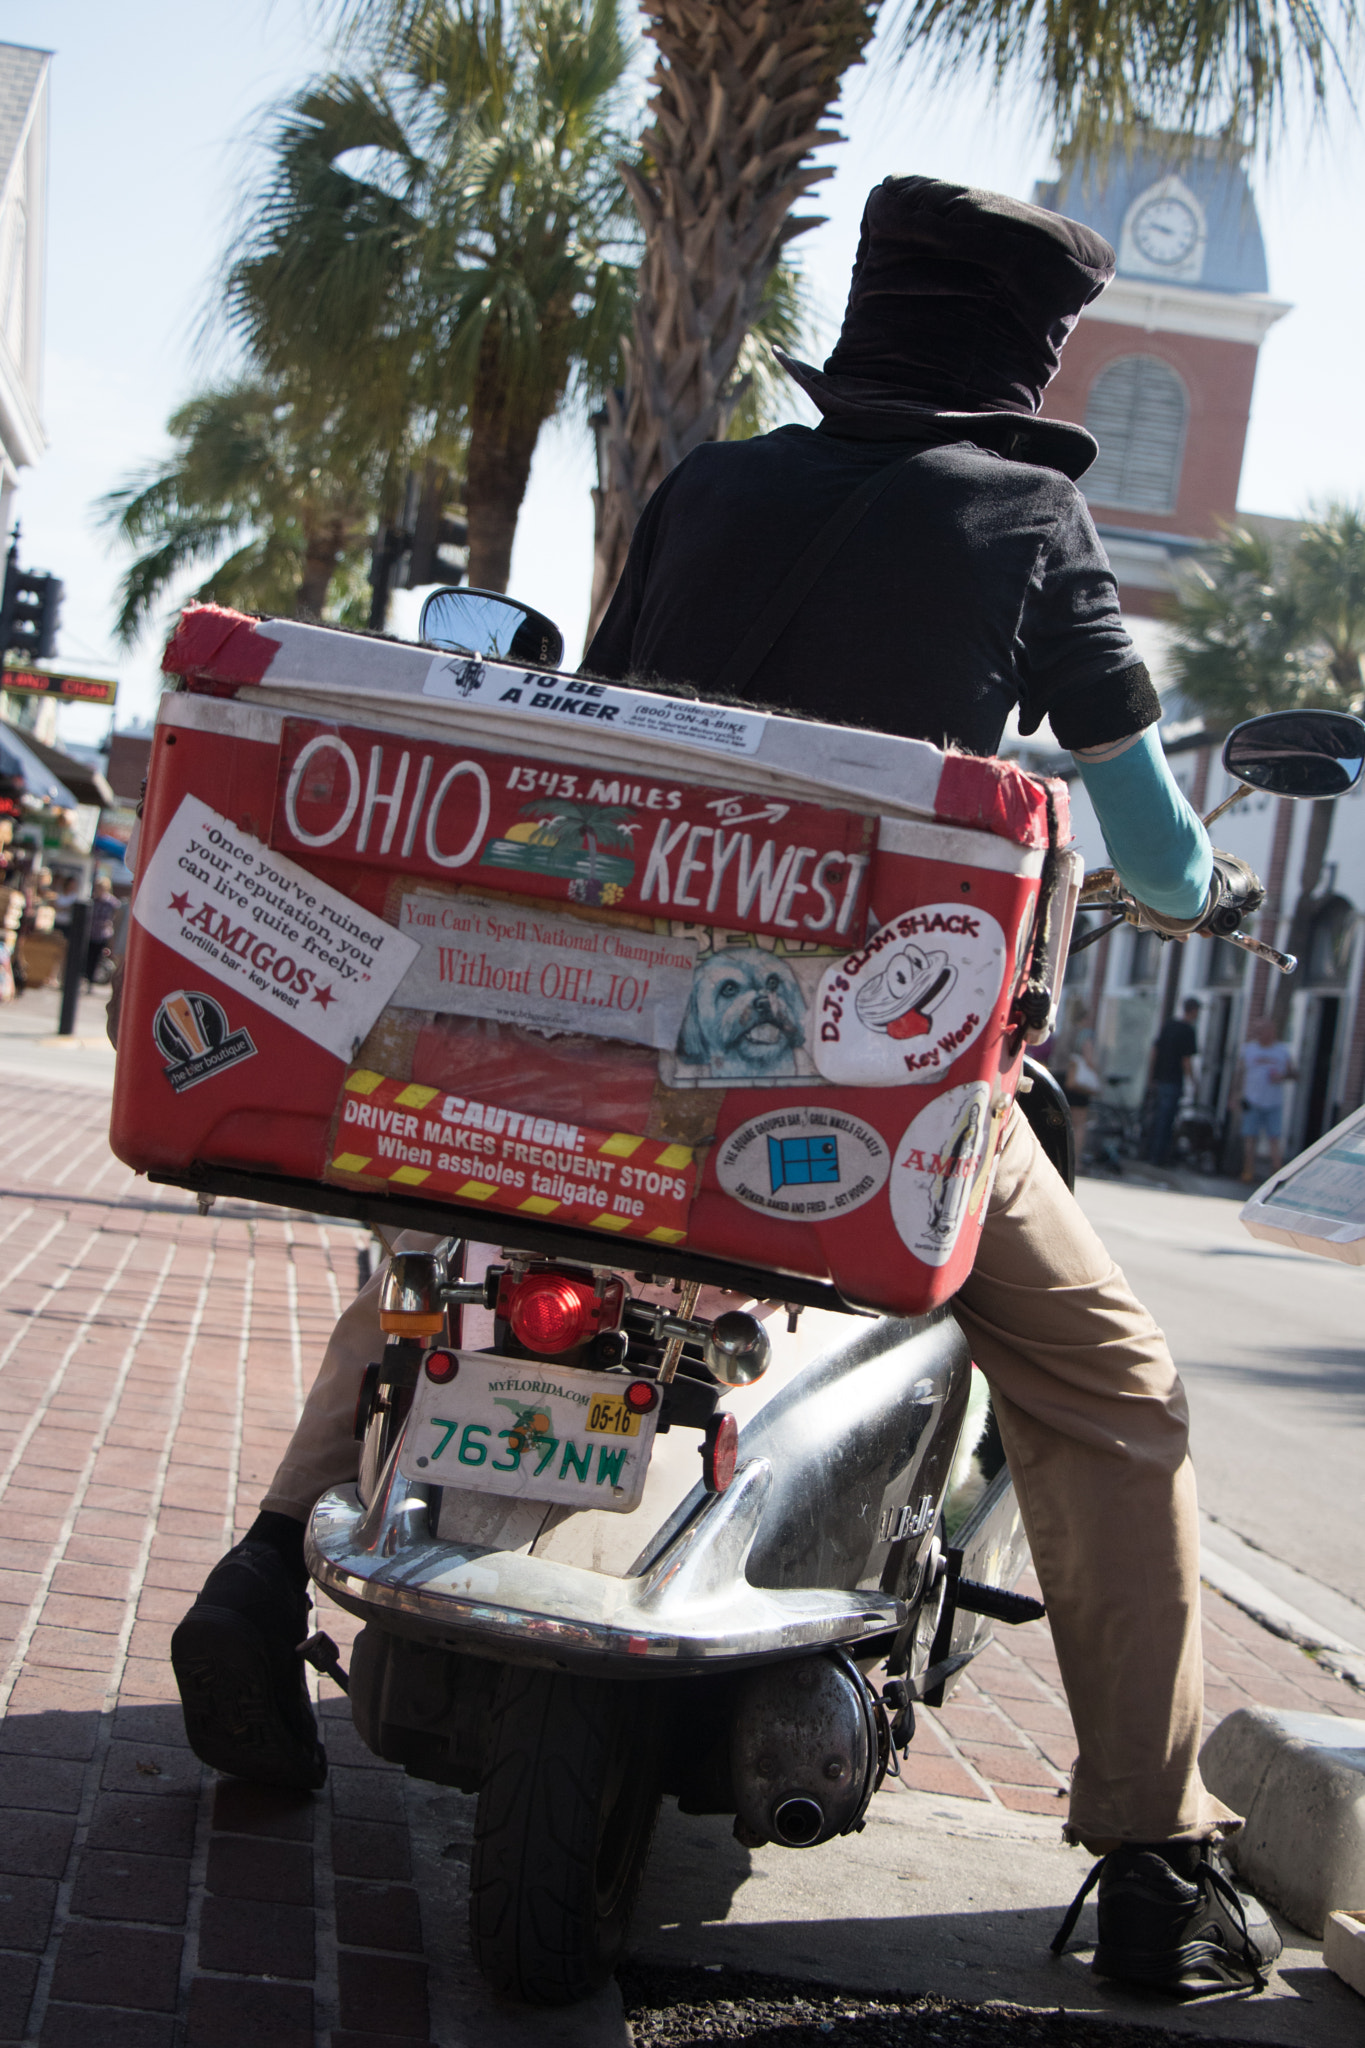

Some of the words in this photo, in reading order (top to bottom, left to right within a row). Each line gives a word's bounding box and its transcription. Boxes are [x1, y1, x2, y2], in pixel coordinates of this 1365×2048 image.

[499, 687, 526, 703] A
[528, 692, 620, 722] BIKER
[523, 672, 557, 688] TO
[564, 681, 608, 697] BE
[635, 705, 671, 719] (800)
[675, 712, 747, 733] ON-A-BIKE
[285, 734, 490, 868] OHIO
[178, 855, 210, 885] can
[216, 875, 249, 909] live
[251, 903, 300, 942] quite
[186, 839, 232, 877] your
[235, 869, 333, 945] reputation,
[336, 939, 375, 968] you
[255, 862, 317, 908] you've
[319, 902, 385, 951] ruined
[187, 902, 317, 995] AMIGOS
[405, 903, 436, 928] You
[441, 908, 483, 934] Can't
[486, 916, 527, 942] Spell
[531, 923, 599, 953] National
[602, 935, 693, 970] Champions
[843, 929, 897, 976] CLAM
[897, 912, 980, 938] SHACK
[180, 926, 221, 958] tortilla
[220, 953, 243, 972] bar
[248, 970, 272, 991] key
[271, 987, 301, 1010] west
[438, 946, 533, 995] Without
[204, 1040, 247, 1068] boutique
[903, 1047, 941, 1072] Key
[937, 1012, 980, 1052] West
[343, 1099, 419, 1139] DRIVER
[423, 1120, 497, 1155] MAKES
[502, 1140, 616, 1182] FREQUENT
[619, 1166, 687, 1201] STOPS
[442, 1096, 585, 1152] CAUTION:
[723, 1148, 739, 1166] THE
[732, 1128, 757, 1154] SQUARE
[754, 1115, 787, 1135] GROUPER
[787, 1113, 801, 1126] BAR
[810, 1113, 828, 1126] GRILL
[377, 1134, 432, 1166] When
[437, 1148, 526, 1188] assholes
[531, 1170, 607, 1211] tailgate
[613, 1193, 645, 1217] me
[791, 1202, 806, 1213] AND
[807, 1201, 827, 1214] FRIED
[835, 1193, 851, 1207] GET
[850, 1175, 876, 1202] HOOKED
[488, 1379, 590, 1407] MYFLORIDA.COM
[590, 1403, 631, 1433] 05-16
[430, 1417, 628, 1487] 7637NW
